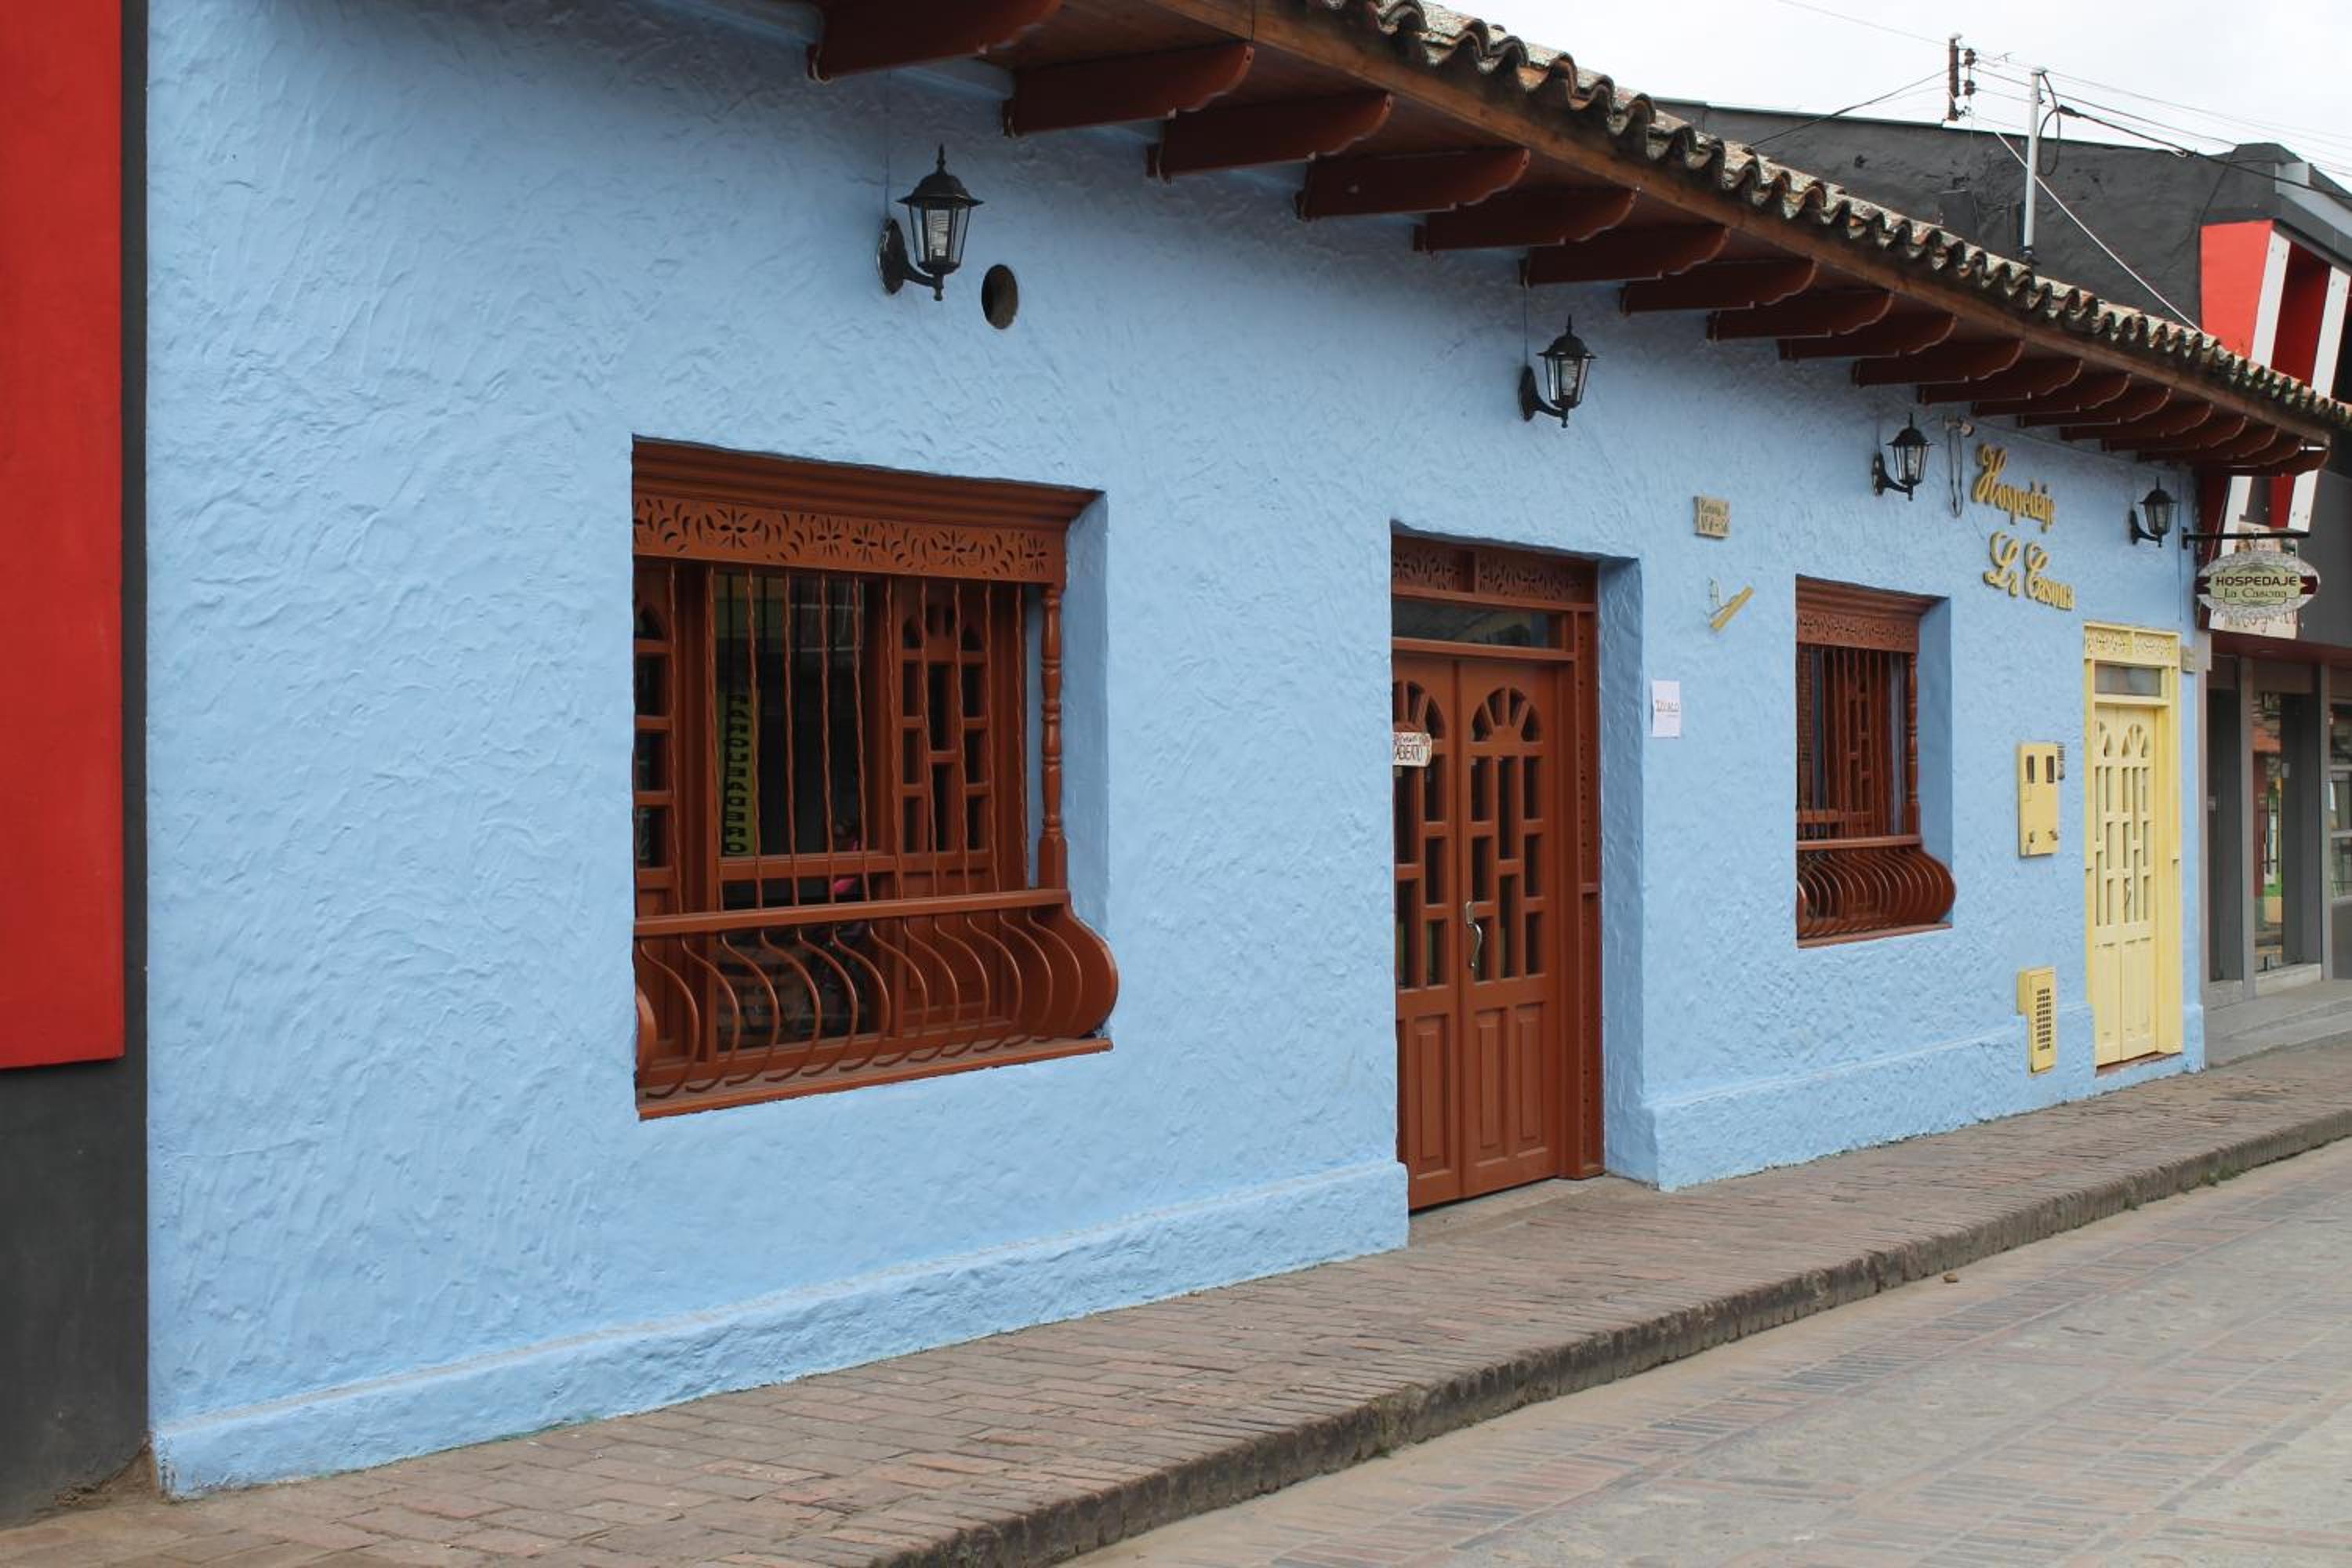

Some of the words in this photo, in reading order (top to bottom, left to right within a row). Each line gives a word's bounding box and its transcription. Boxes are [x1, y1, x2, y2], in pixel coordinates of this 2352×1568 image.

[1971, 443, 2056, 533] Hospedaje
[1983, 531, 2020, 597] La
[2024, 540, 2074, 612] Casona
[2216, 575, 2297, 586] HOSPEDAJE
[2224, 588, 2237, 598] La
[2242, 587, 2287, 598] Casona
